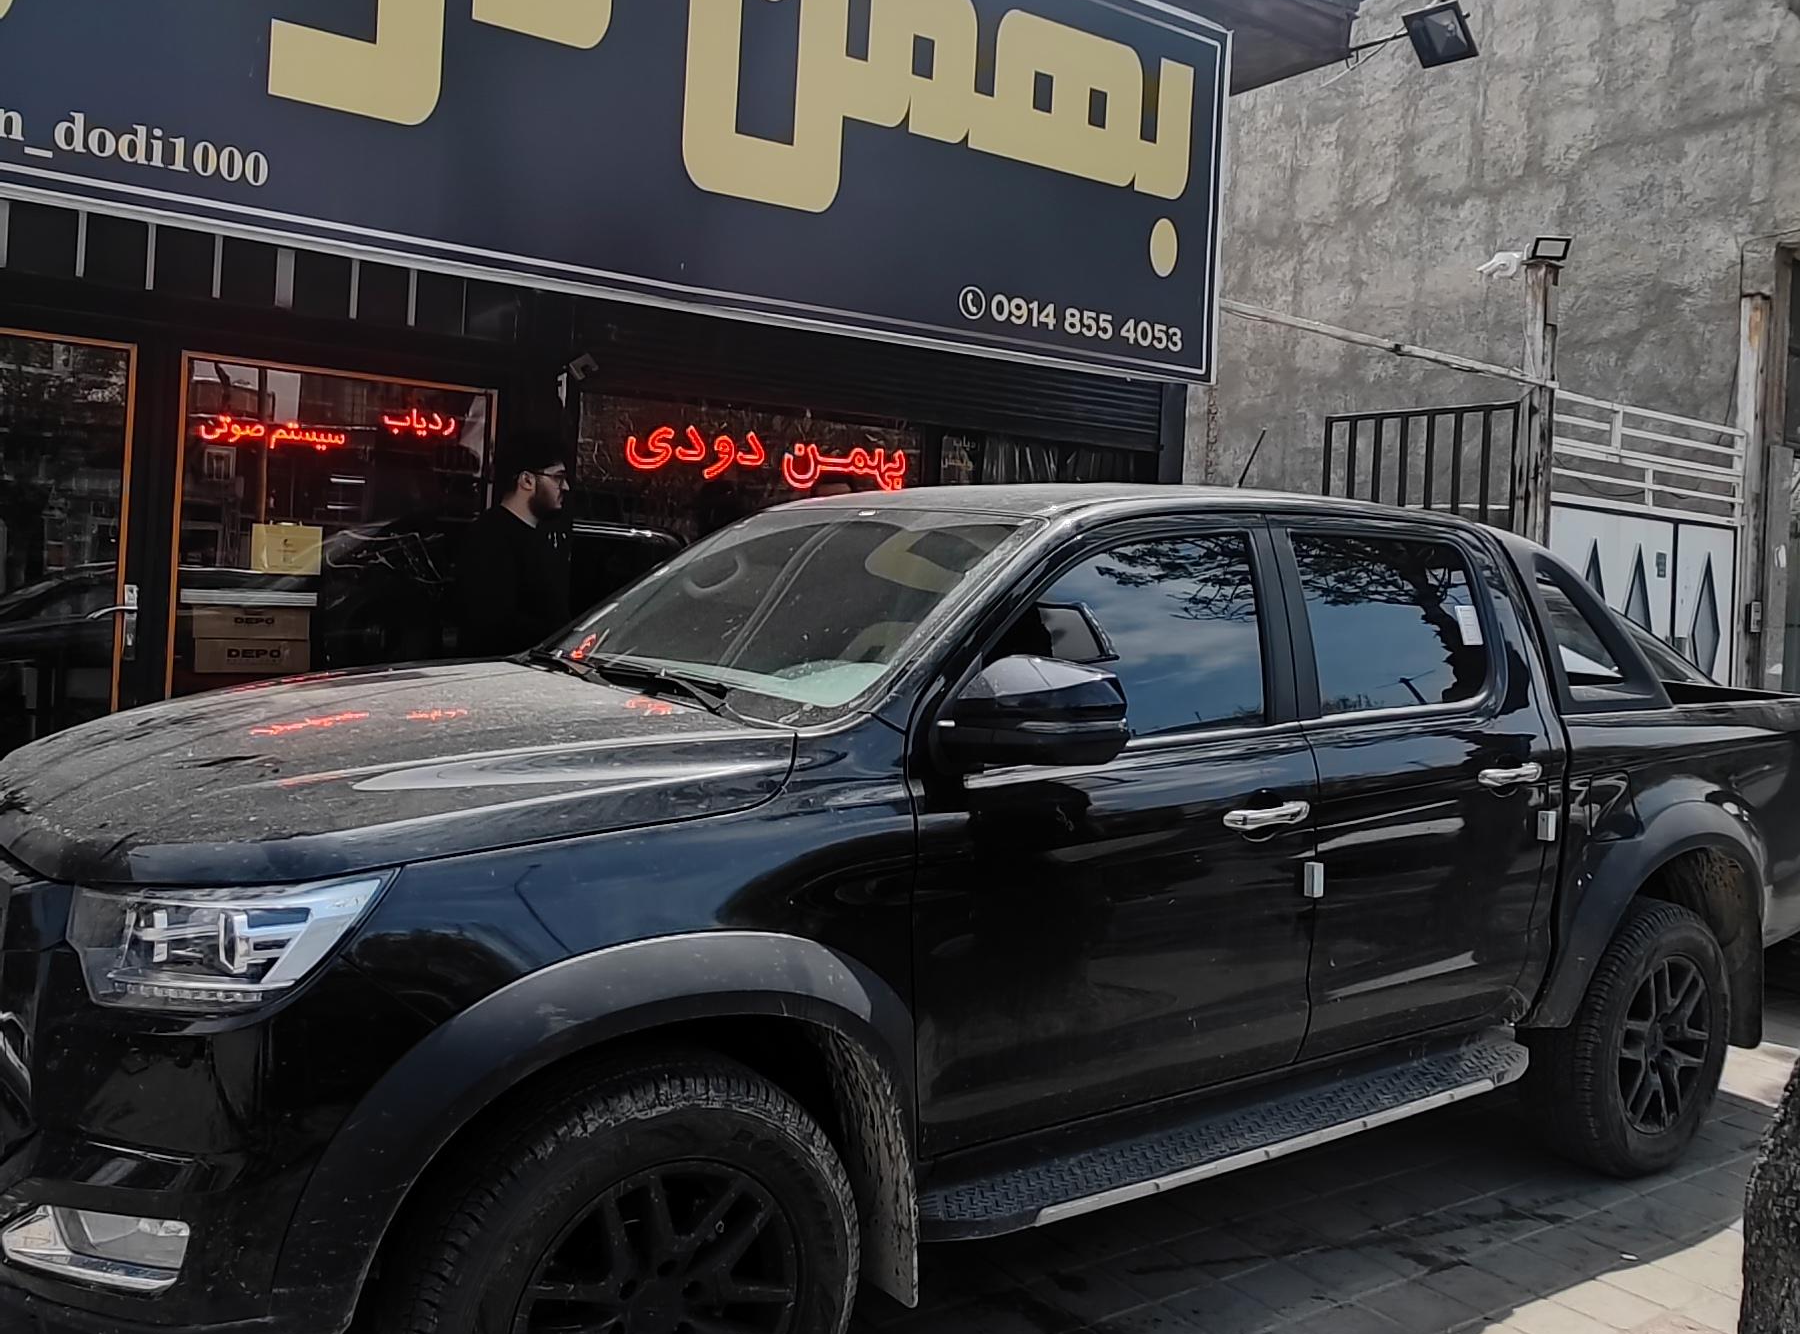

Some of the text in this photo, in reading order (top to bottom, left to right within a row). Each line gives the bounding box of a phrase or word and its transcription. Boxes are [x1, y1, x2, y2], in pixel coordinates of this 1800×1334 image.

[990, 293, 1183, 352] 0914 855 4053
[268, 421, 347, 451] سیستم
[382, 407, 456, 437] ردیاب
[625, 424, 906, 492] بهمن دودی
[234, 617, 275, 626] DEPO
[227, 648, 282, 659] DEPO
